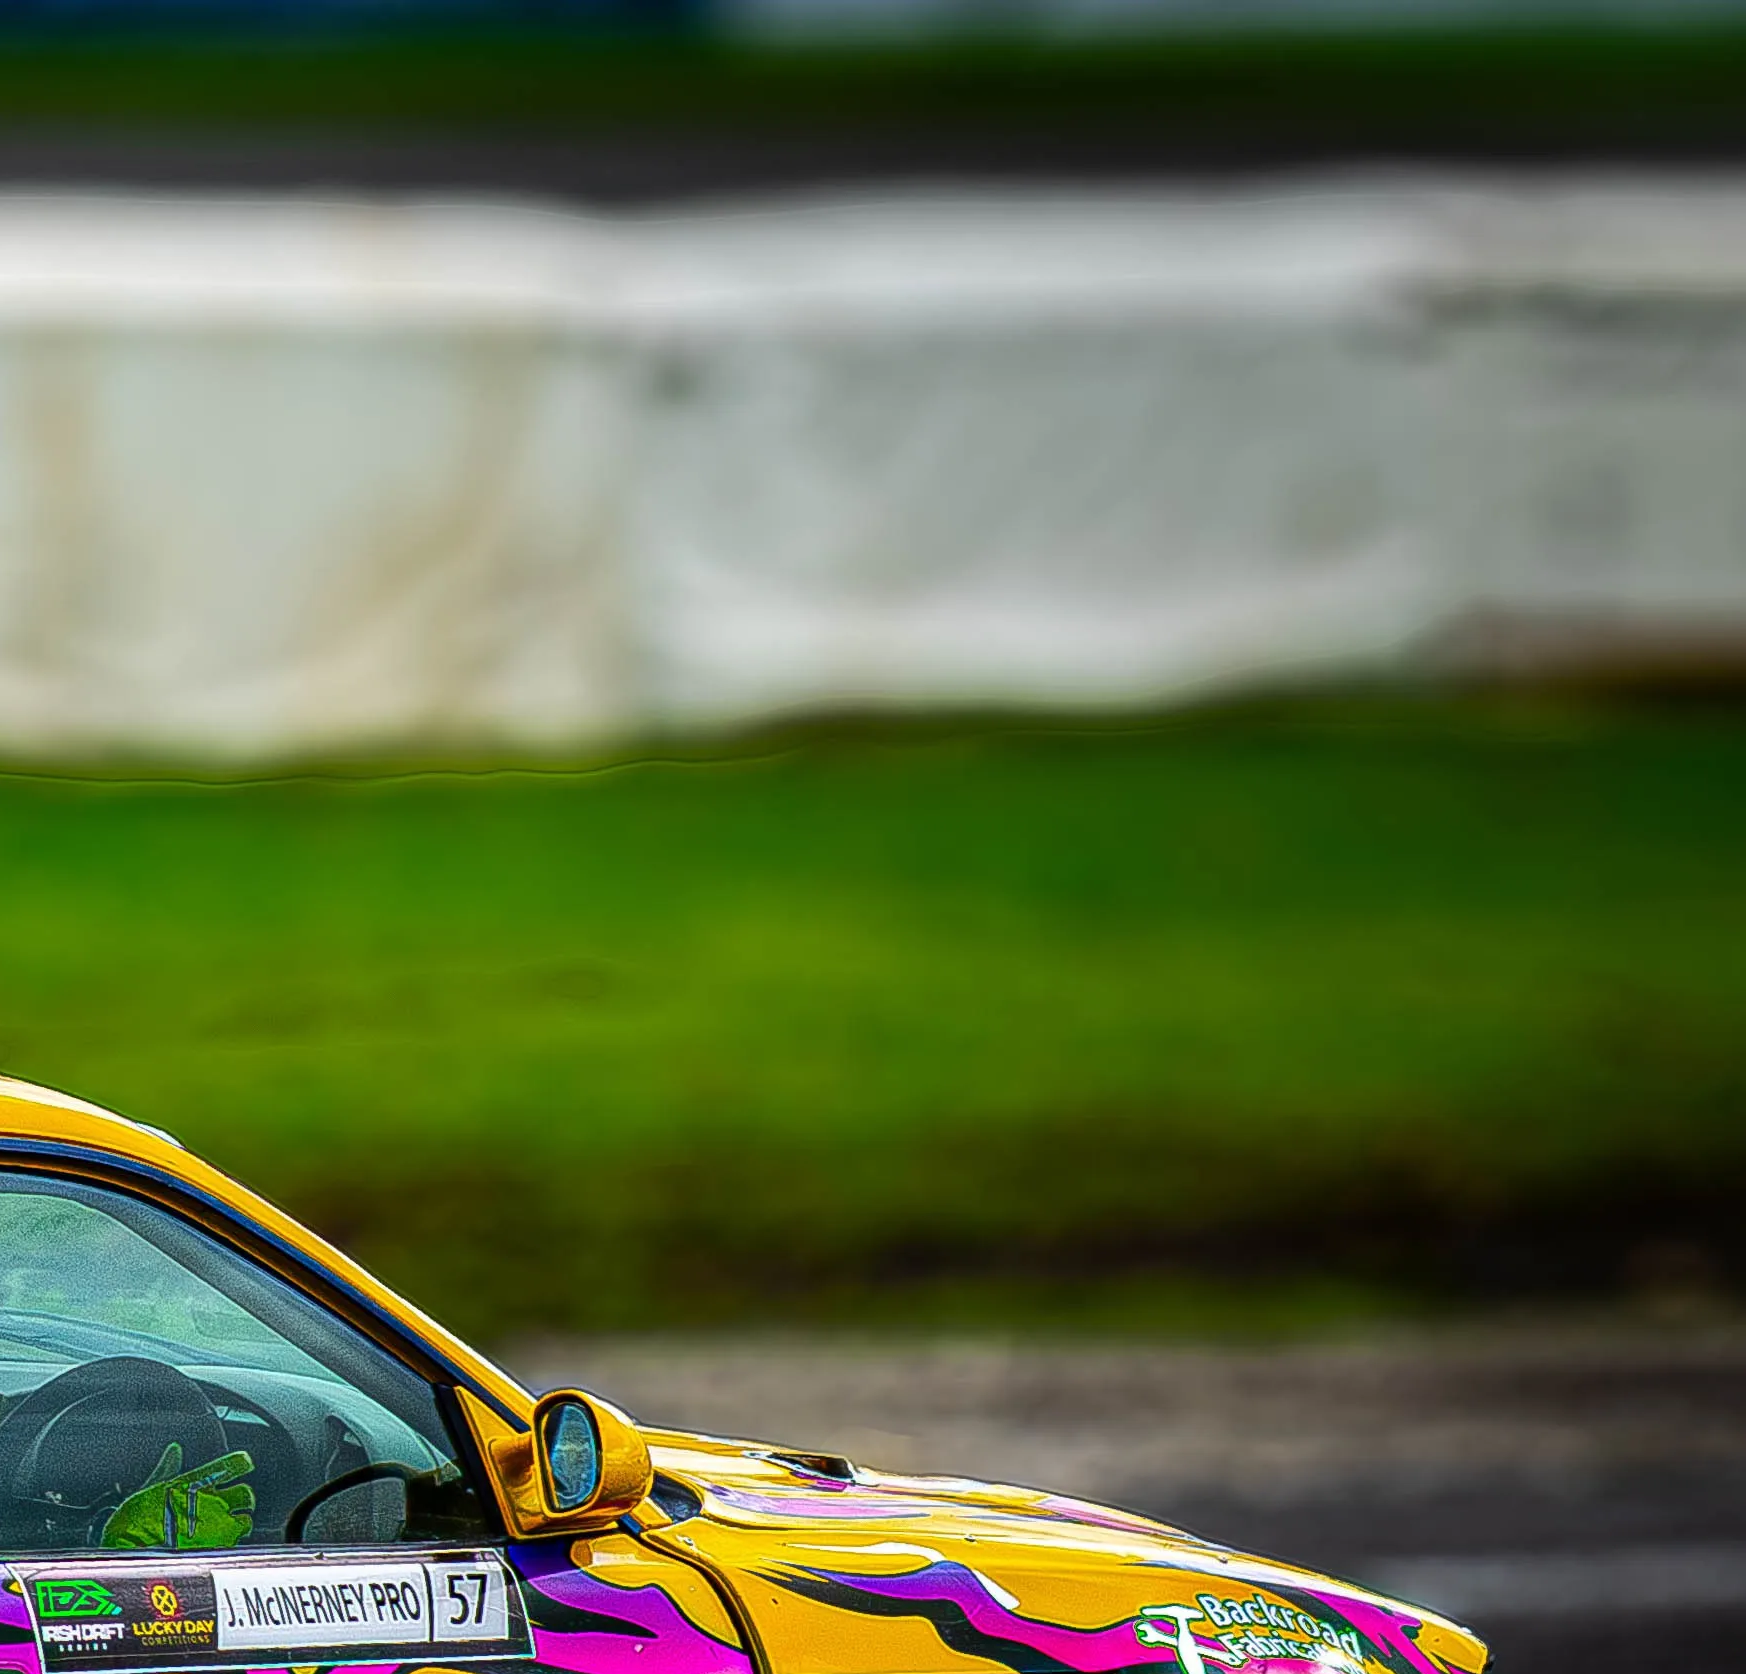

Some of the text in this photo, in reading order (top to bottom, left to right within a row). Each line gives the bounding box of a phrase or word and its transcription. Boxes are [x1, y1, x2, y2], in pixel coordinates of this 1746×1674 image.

[223, 1574, 488, 1627] J. McINERNEY PRO 57
[132, 1620, 214, 1636] LUCKY DAY
[1197, 1594, 1364, 1665] Backroad
